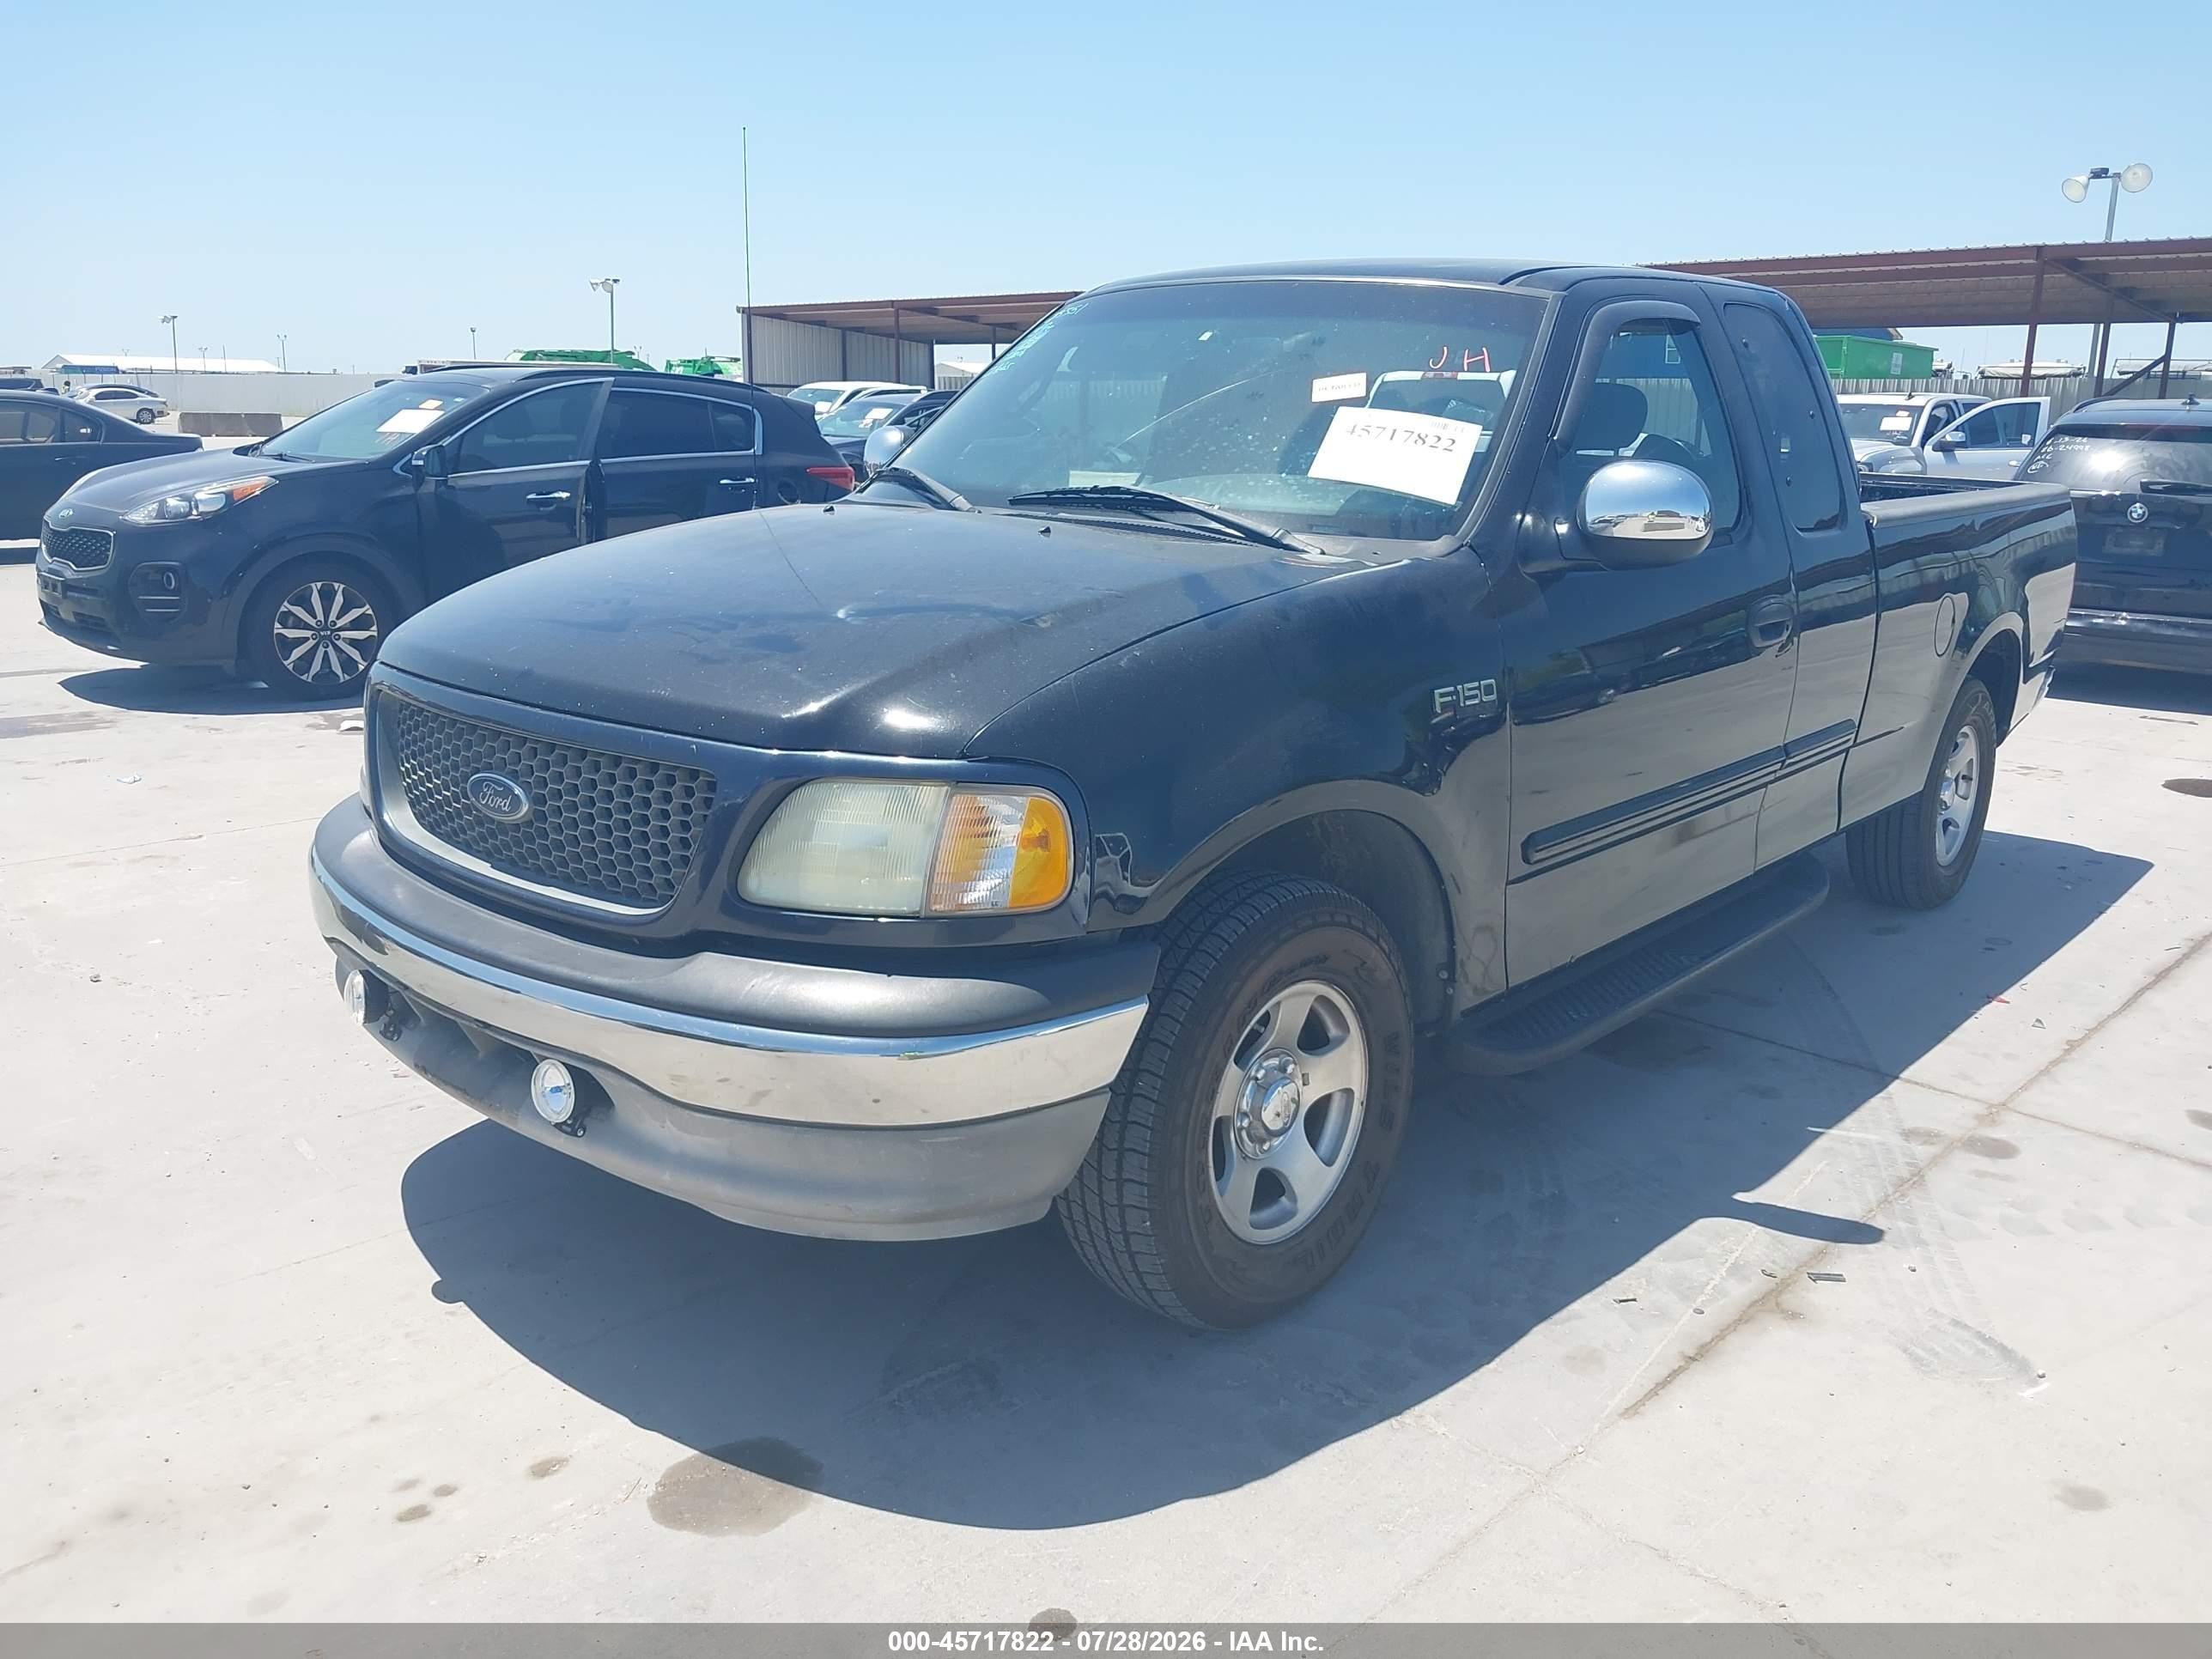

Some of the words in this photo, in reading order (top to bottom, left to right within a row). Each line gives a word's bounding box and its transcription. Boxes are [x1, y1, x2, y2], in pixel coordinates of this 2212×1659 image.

[1463, 347, 1490, 372] H
[1346, 424, 1456, 452] 45717822
[479, 781, 513, 811] Ford
